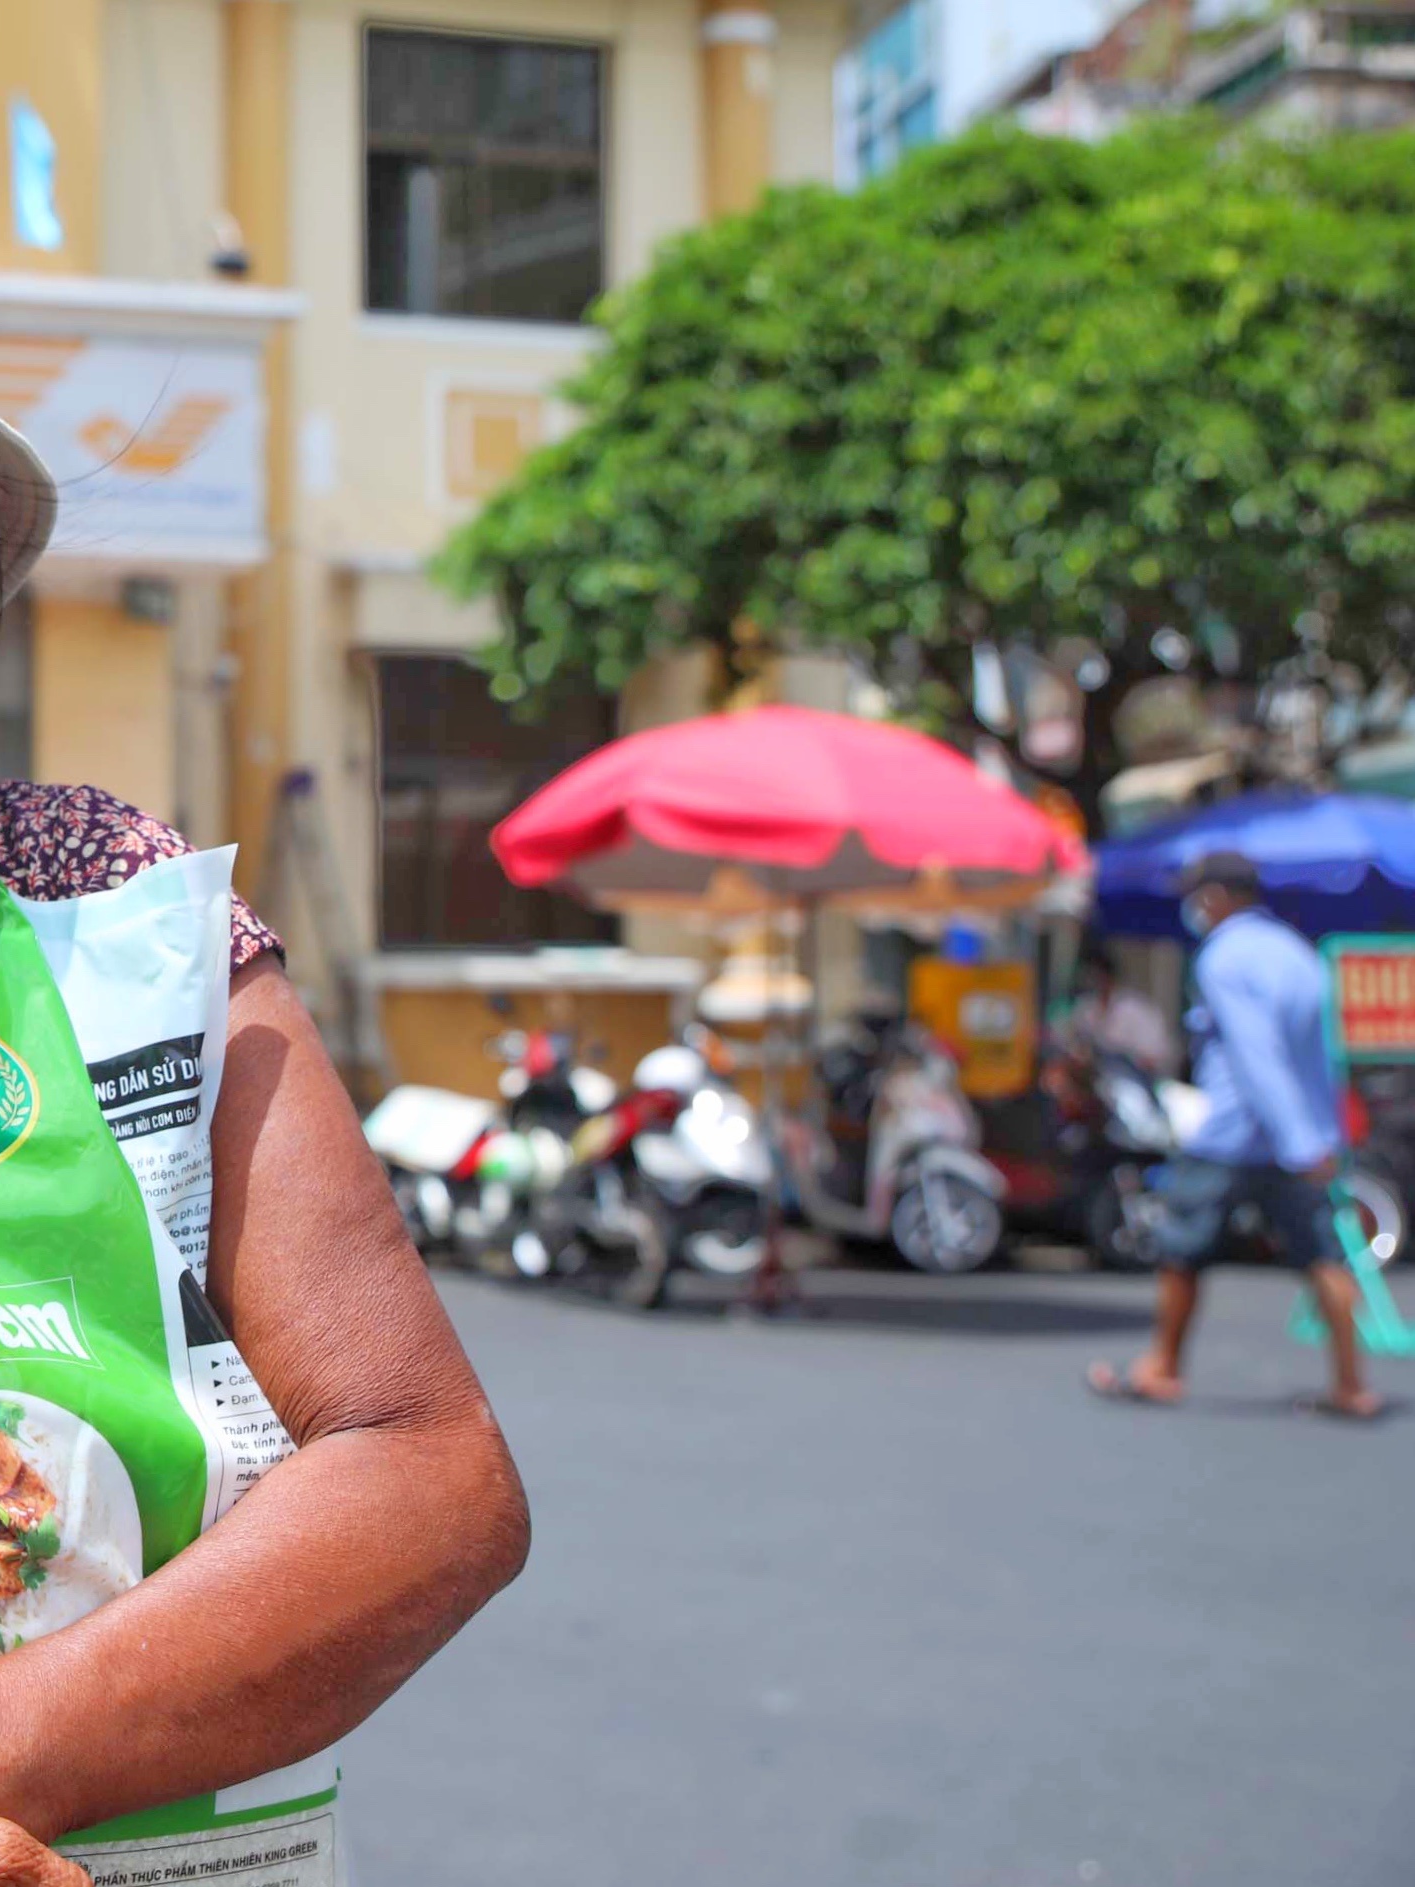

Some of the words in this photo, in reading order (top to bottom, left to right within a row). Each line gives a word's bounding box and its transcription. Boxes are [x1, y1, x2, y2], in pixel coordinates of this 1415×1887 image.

[93, 1080, 117, 1103] NG
[119, 1066, 150, 1097] DẪN
[152, 1056, 177, 1087] SỬ
[152, 1111, 174, 1129] CƠM
[223, 1422, 258, 1436] Thành
[254, 1437, 276, 1449] tính
[131, 1868, 162, 1883] THỰC
[165, 1859, 196, 1879] PHẨM
[199, 1857, 229, 1874] THIÊN
[231, 1852, 262, 1869] NHIÊN
[264, 1847, 287, 1863] KING
[288, 1839, 318, 1858] GREEN
